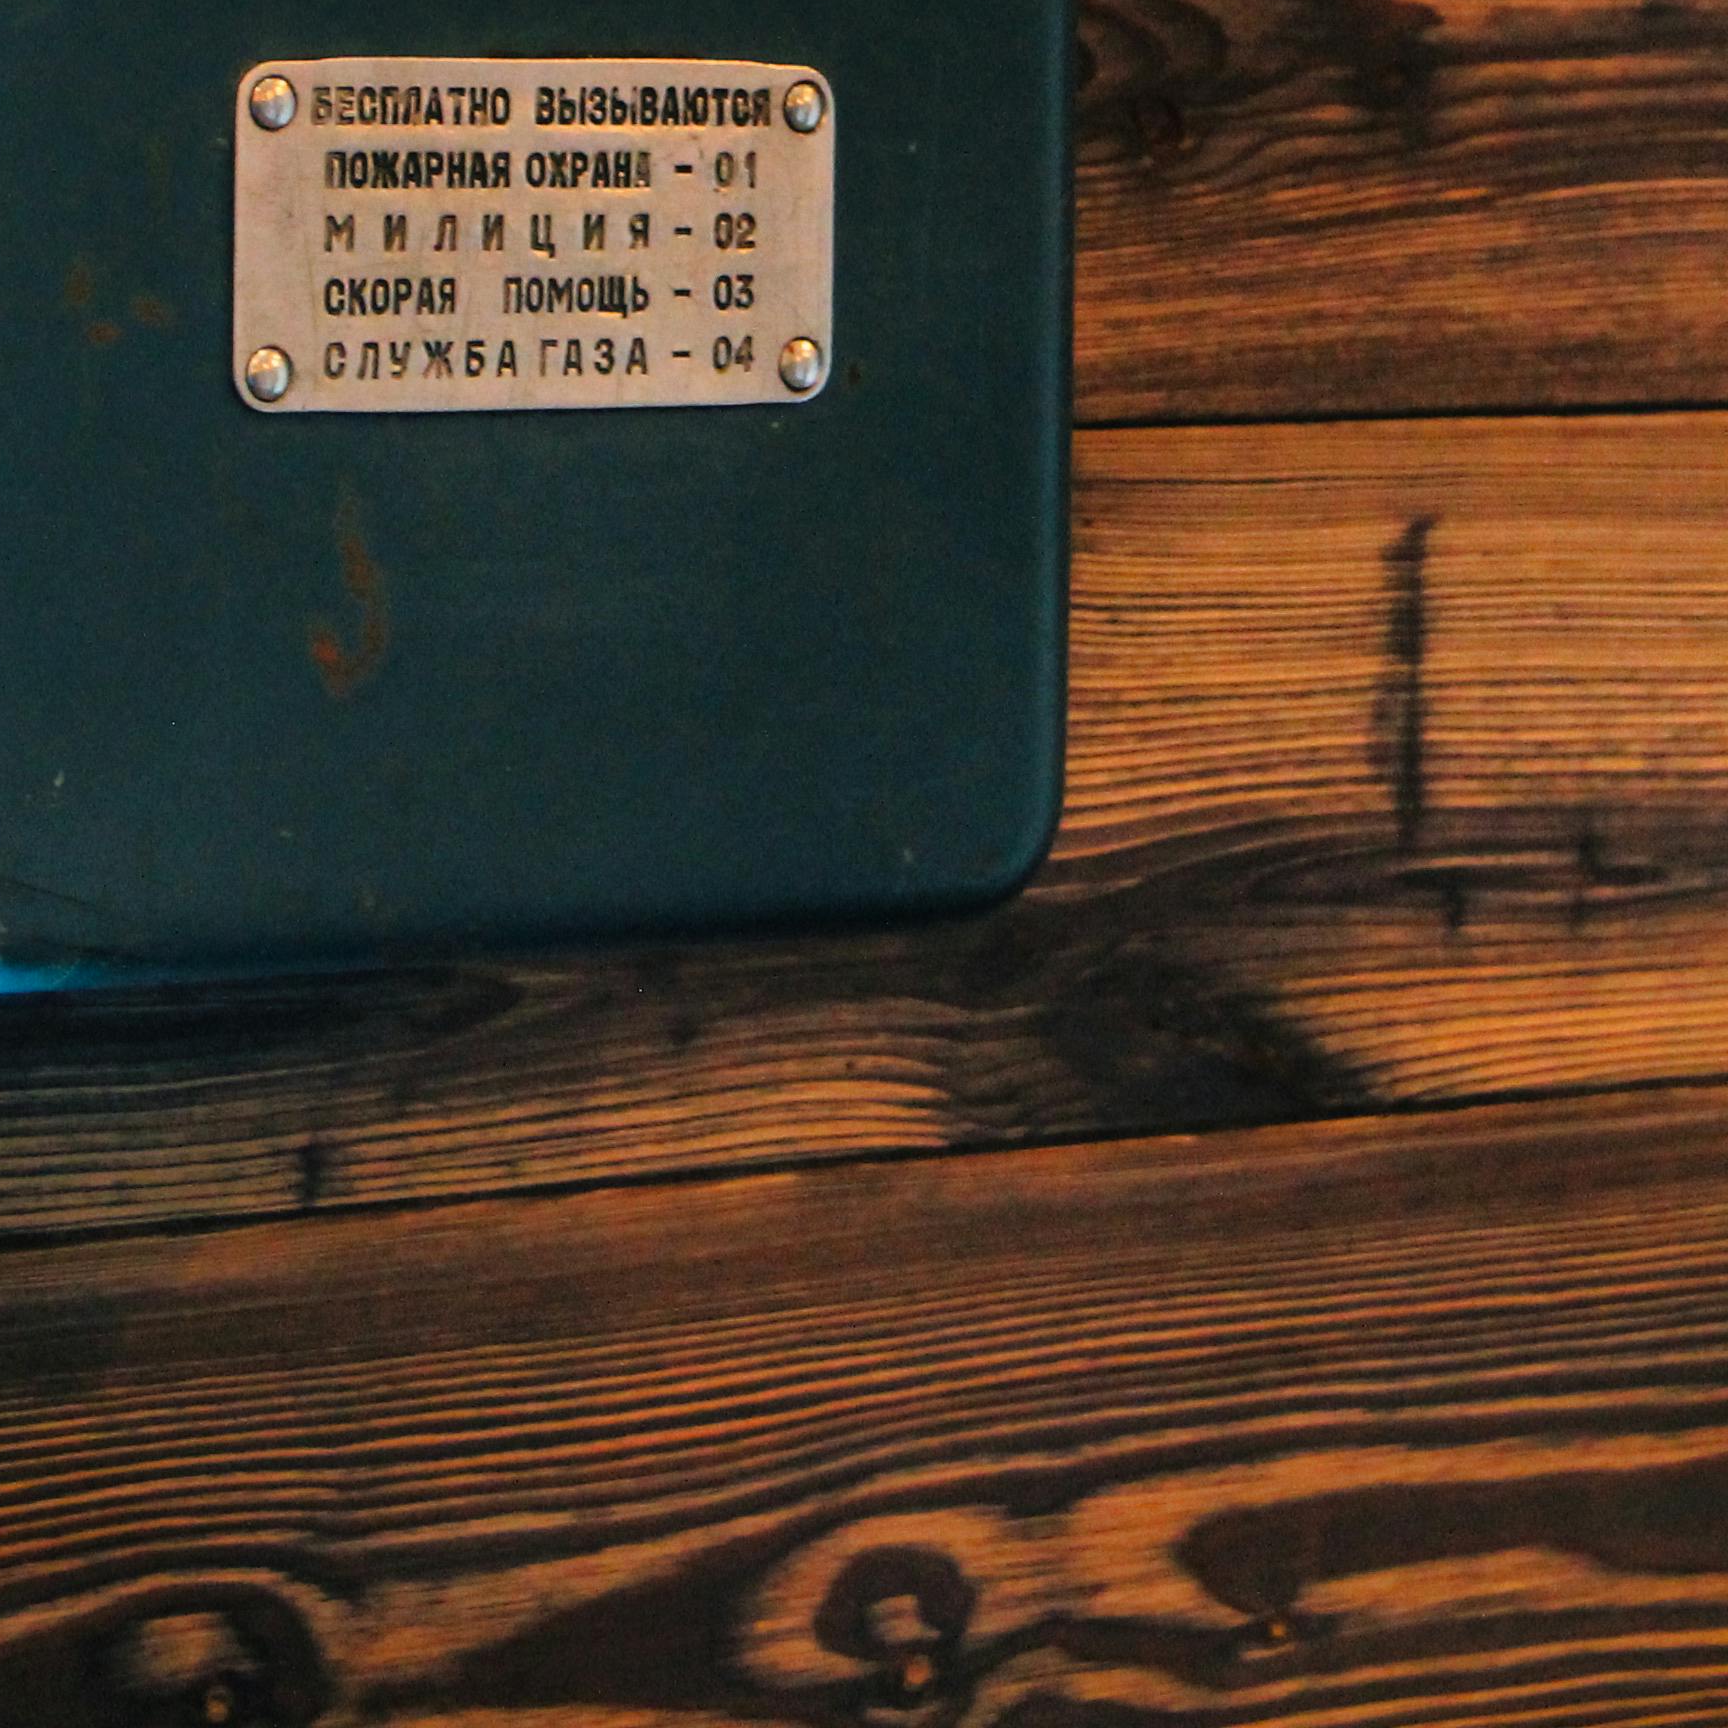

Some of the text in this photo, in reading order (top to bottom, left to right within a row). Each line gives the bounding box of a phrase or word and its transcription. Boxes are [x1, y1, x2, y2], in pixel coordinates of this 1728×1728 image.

[311, 86, 771, 126] БЕСПЛАТНО ВЫЗЫВАЮТСЯ
[325, 151, 510, 189] ПОЖАРНАЯ
[525, 151, 651, 189] ОХРАНА
[715, 151, 757, 190] 01
[323, 213, 651, 258] МИЛИЦИЯ
[713, 212, 757, 251] 02
[323, 277, 456, 316] СКОРАЯ
[503, 275, 650, 318] ПОМОЩЬ
[712, 274, 756, 311] 03
[323, 339, 518, 380] СЛУЖБА
[539, 337, 649, 377] ГАЗА
[712, 335, 754, 374] 04
